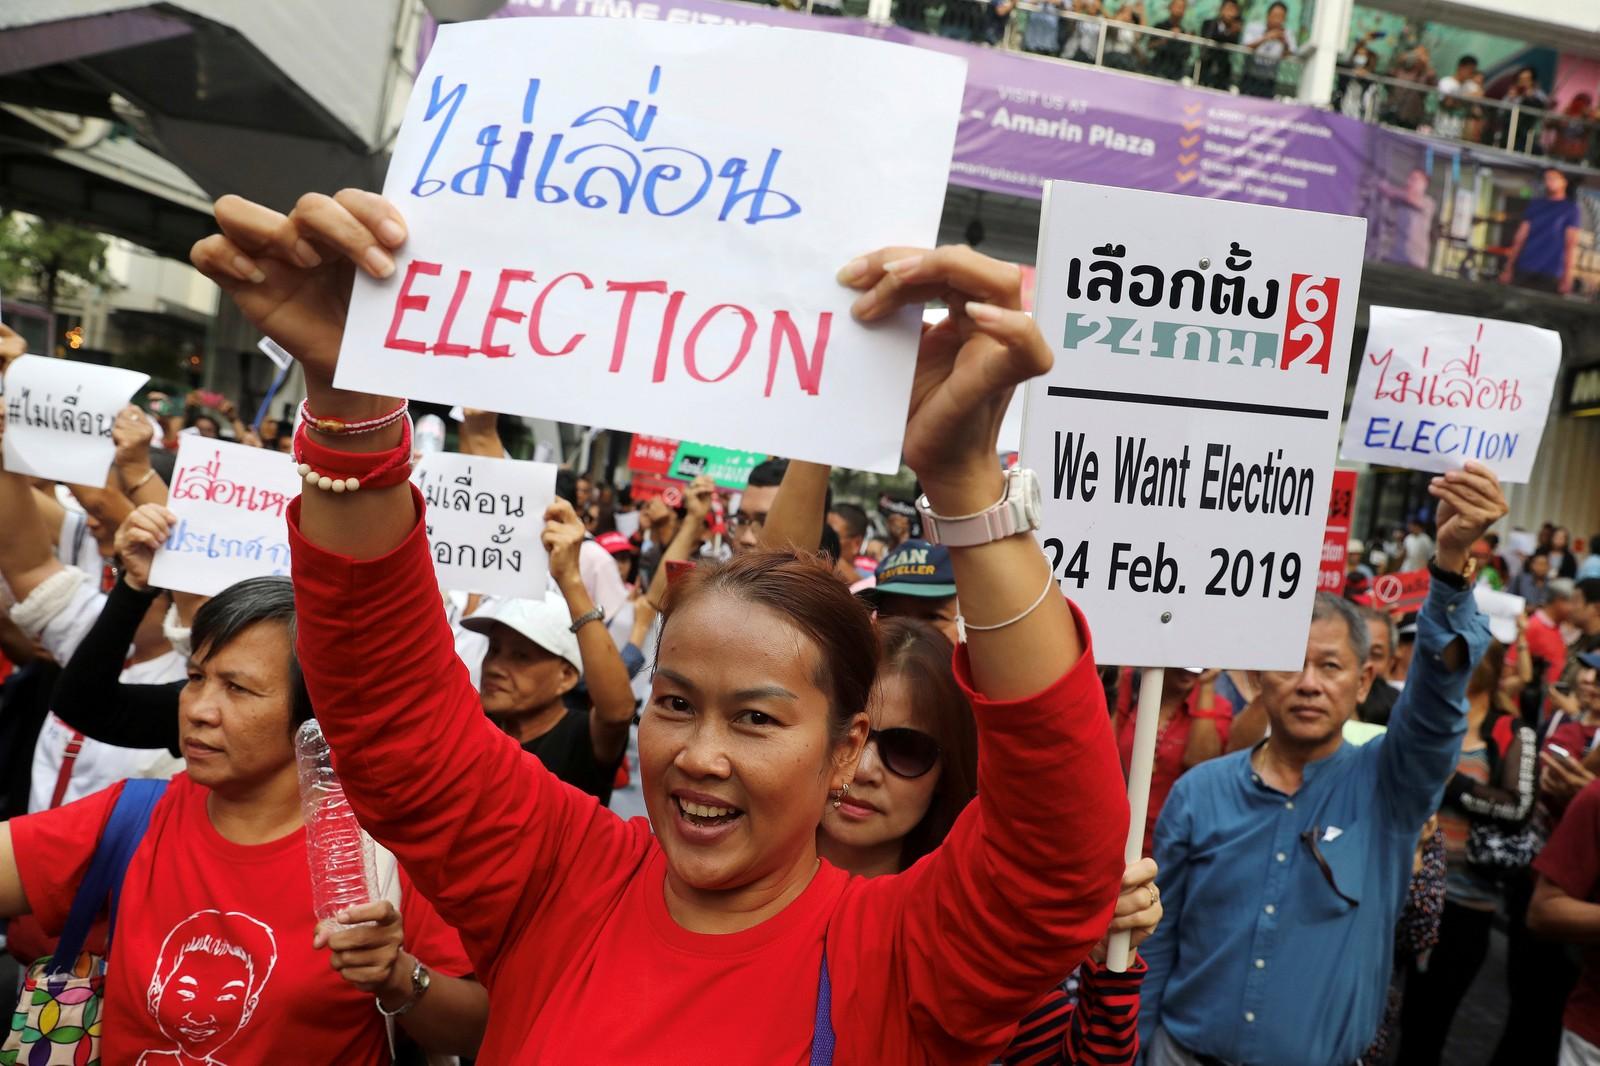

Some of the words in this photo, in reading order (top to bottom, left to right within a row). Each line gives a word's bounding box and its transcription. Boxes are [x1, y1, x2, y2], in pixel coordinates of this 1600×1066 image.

[410, 65, 802, 225] ไม่เลื่อน
[991, 107, 1083, 143] Amarin
[1089, 124, 1156, 157] Plaza
[1066, 241, 1280, 320] เลือกตั้ง
[383, 259, 833, 398] ELECTION
[1075, 313, 1159, 356] 24
[1368, 323, 1522, 412] ไม่เลื่อน
[1364, 416, 1519, 461] ELECTION
[172, 450, 292, 518] เลื่อนห
[1053, 431, 1099, 503] We
[1114, 436, 1191, 509] Want
[1199, 443, 1314, 516] Election
[1043, 537, 1090, 589] 24
[1107, 541, 1186, 594] Feb.
[1205, 548, 1302, 600] 2019
[1317, 569, 1341, 589] 019
